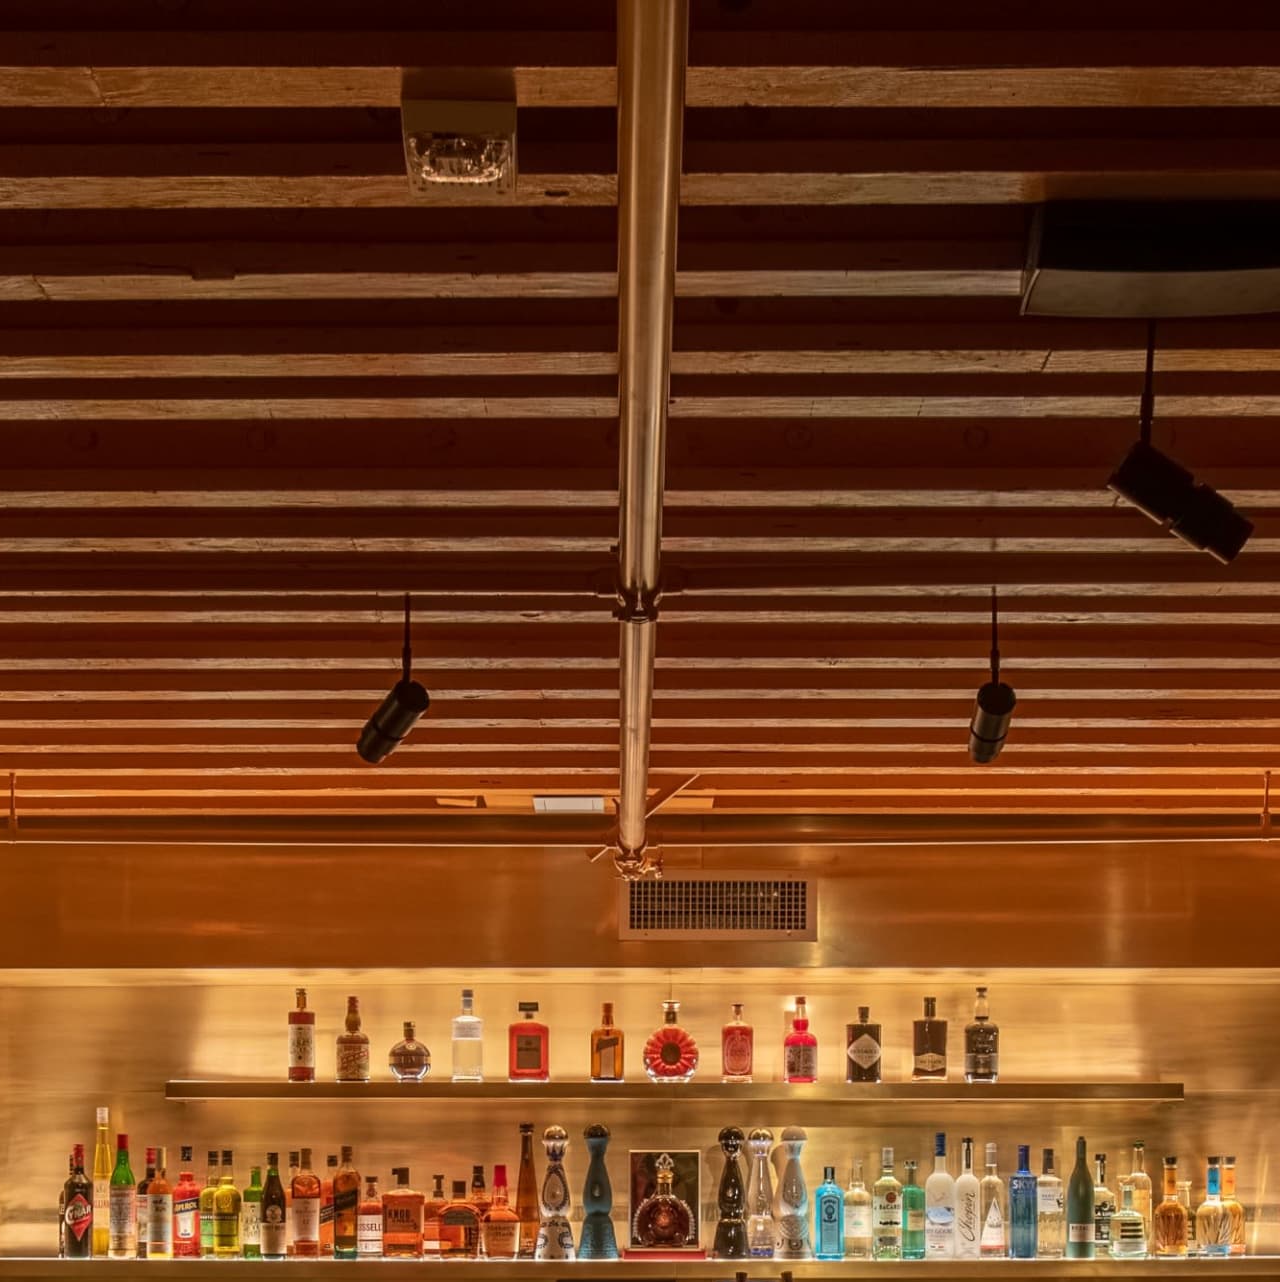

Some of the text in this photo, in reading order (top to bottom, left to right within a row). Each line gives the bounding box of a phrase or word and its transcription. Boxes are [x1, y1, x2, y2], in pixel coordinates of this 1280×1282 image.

[1013, 1180, 1035, 1189] SKYY
[65, 1204, 92, 1225] CYNAR
[959, 1192, 976, 1241] Chopin
